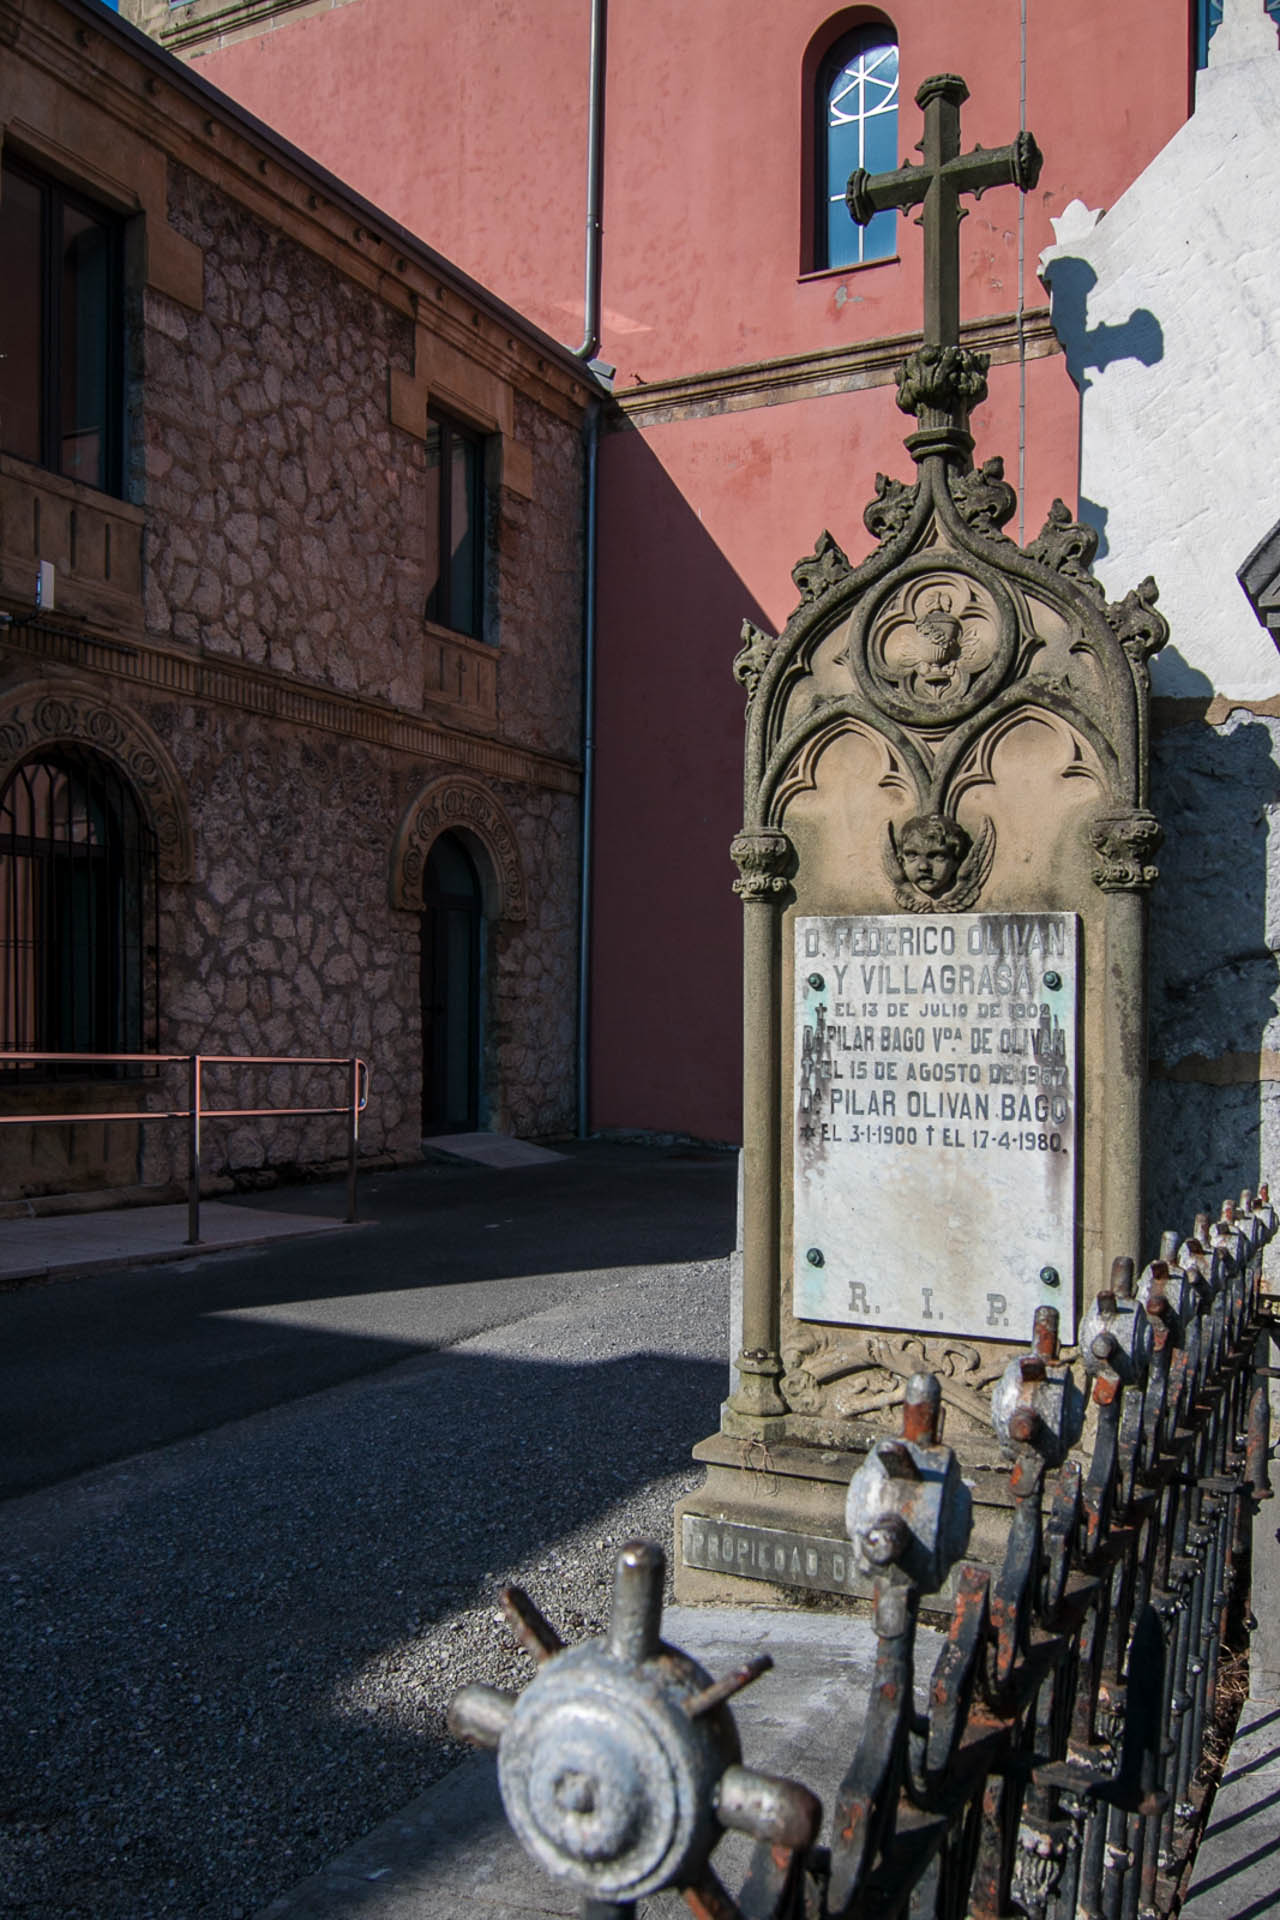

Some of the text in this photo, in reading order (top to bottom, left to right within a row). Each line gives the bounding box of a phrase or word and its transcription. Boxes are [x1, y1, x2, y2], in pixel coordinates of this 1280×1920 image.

[805, 922, 1065, 957] D. FEDERICO OLIVAN
[832, 963, 1034, 996] Y VILLAGRASA
[835, 1003, 856, 1018] EL
[862, 1003, 878, 1018] 13
[887, 1003, 909, 1018] DE
[919, 1003, 968, 1018] JULIO
[977, 1003, 1000, 1018] DE
[826, 1025, 874, 1052] PILAR
[880, 1026, 925, 1053] BAGO
[970, 1028, 993, 1055] DE
[850, 1061, 868, 1080] 15
[874, 1062, 898, 1081] DE
[906, 1062, 981, 1084] AGOSTO
[989, 1063, 1014, 1085] DE
[831, 1088, 896, 1117] PILAR
[907, 1090, 989, 1121] OLIVAN
[1001, 1093, 1068, 1125] BAGO
[821, 1123, 842, 1142] EL
[849, 1124, 917, 1146] 3-1-1900
[943, 1127, 965, 1148] EL
[848, 1281, 1010, 1327] R. I. P.
